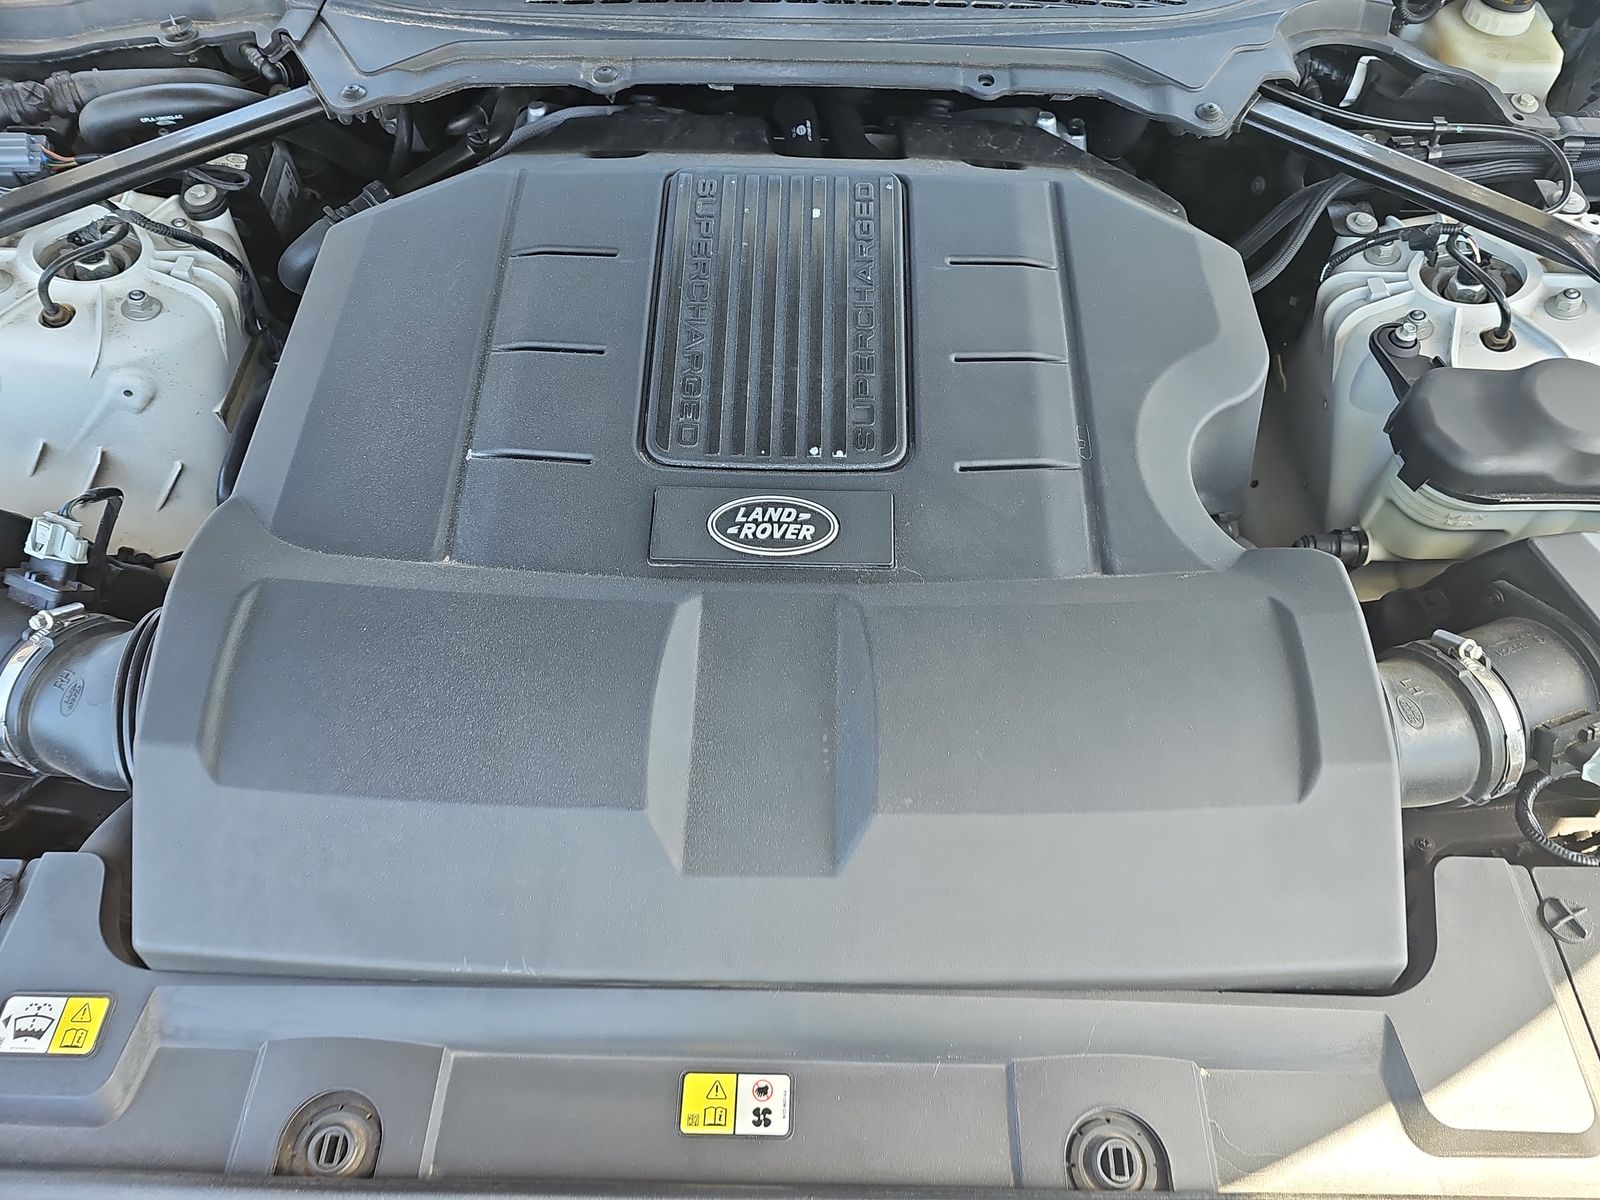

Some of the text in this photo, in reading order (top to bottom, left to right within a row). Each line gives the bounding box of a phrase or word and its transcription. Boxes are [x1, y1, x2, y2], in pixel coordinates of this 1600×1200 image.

[677, 177, 718, 448] SUPERCHARGED
[850, 181, 877, 452] SUPERCHARGED
[735, 507, 798, 522] LAND
[739, 523, 816, 541] ROVER
[53, 668, 76, 692] RH
[1399, 677, 1425, 696] LH
